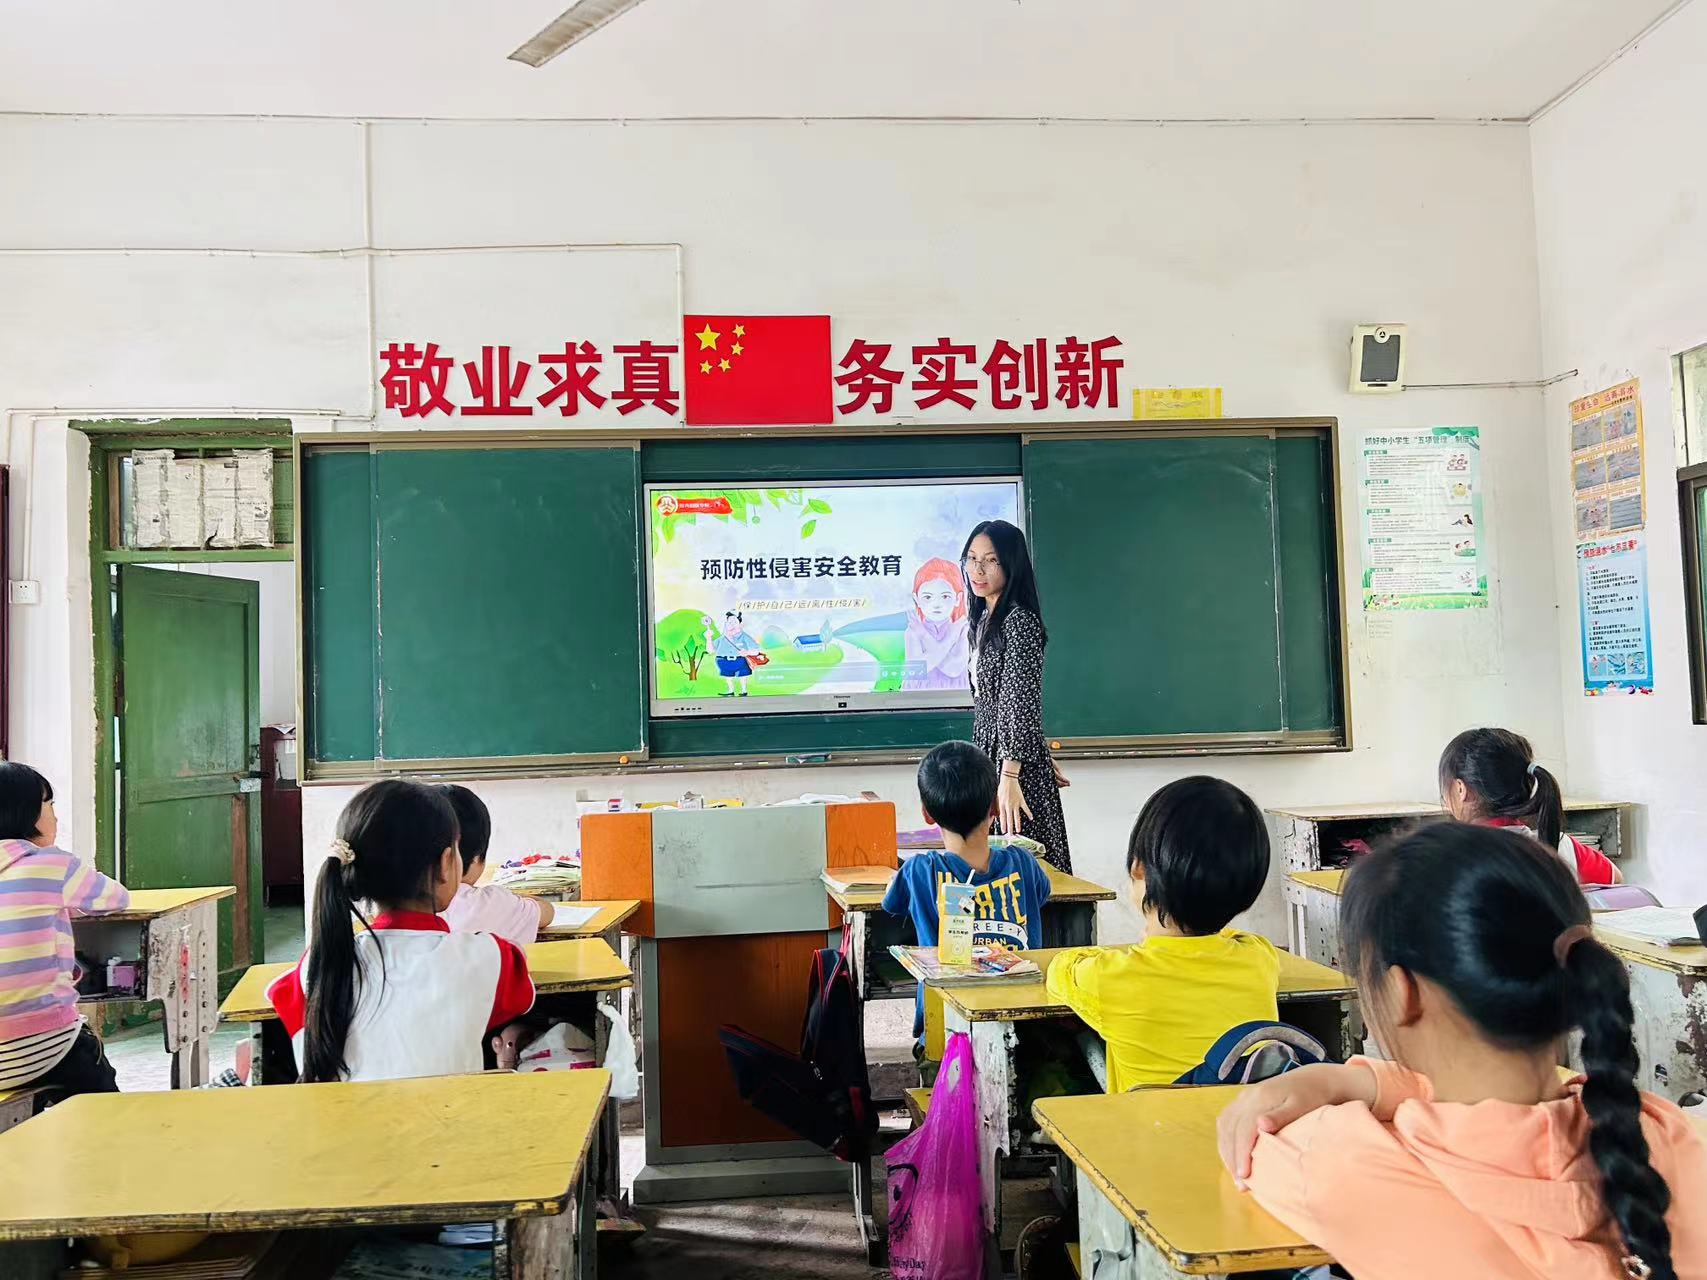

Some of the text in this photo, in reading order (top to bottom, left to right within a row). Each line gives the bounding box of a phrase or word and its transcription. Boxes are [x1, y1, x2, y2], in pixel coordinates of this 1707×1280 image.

[380, 335, 1125, 418] 敬业求真 务实创新
[700, 555, 902, 580] 预防性侵害安全教育
